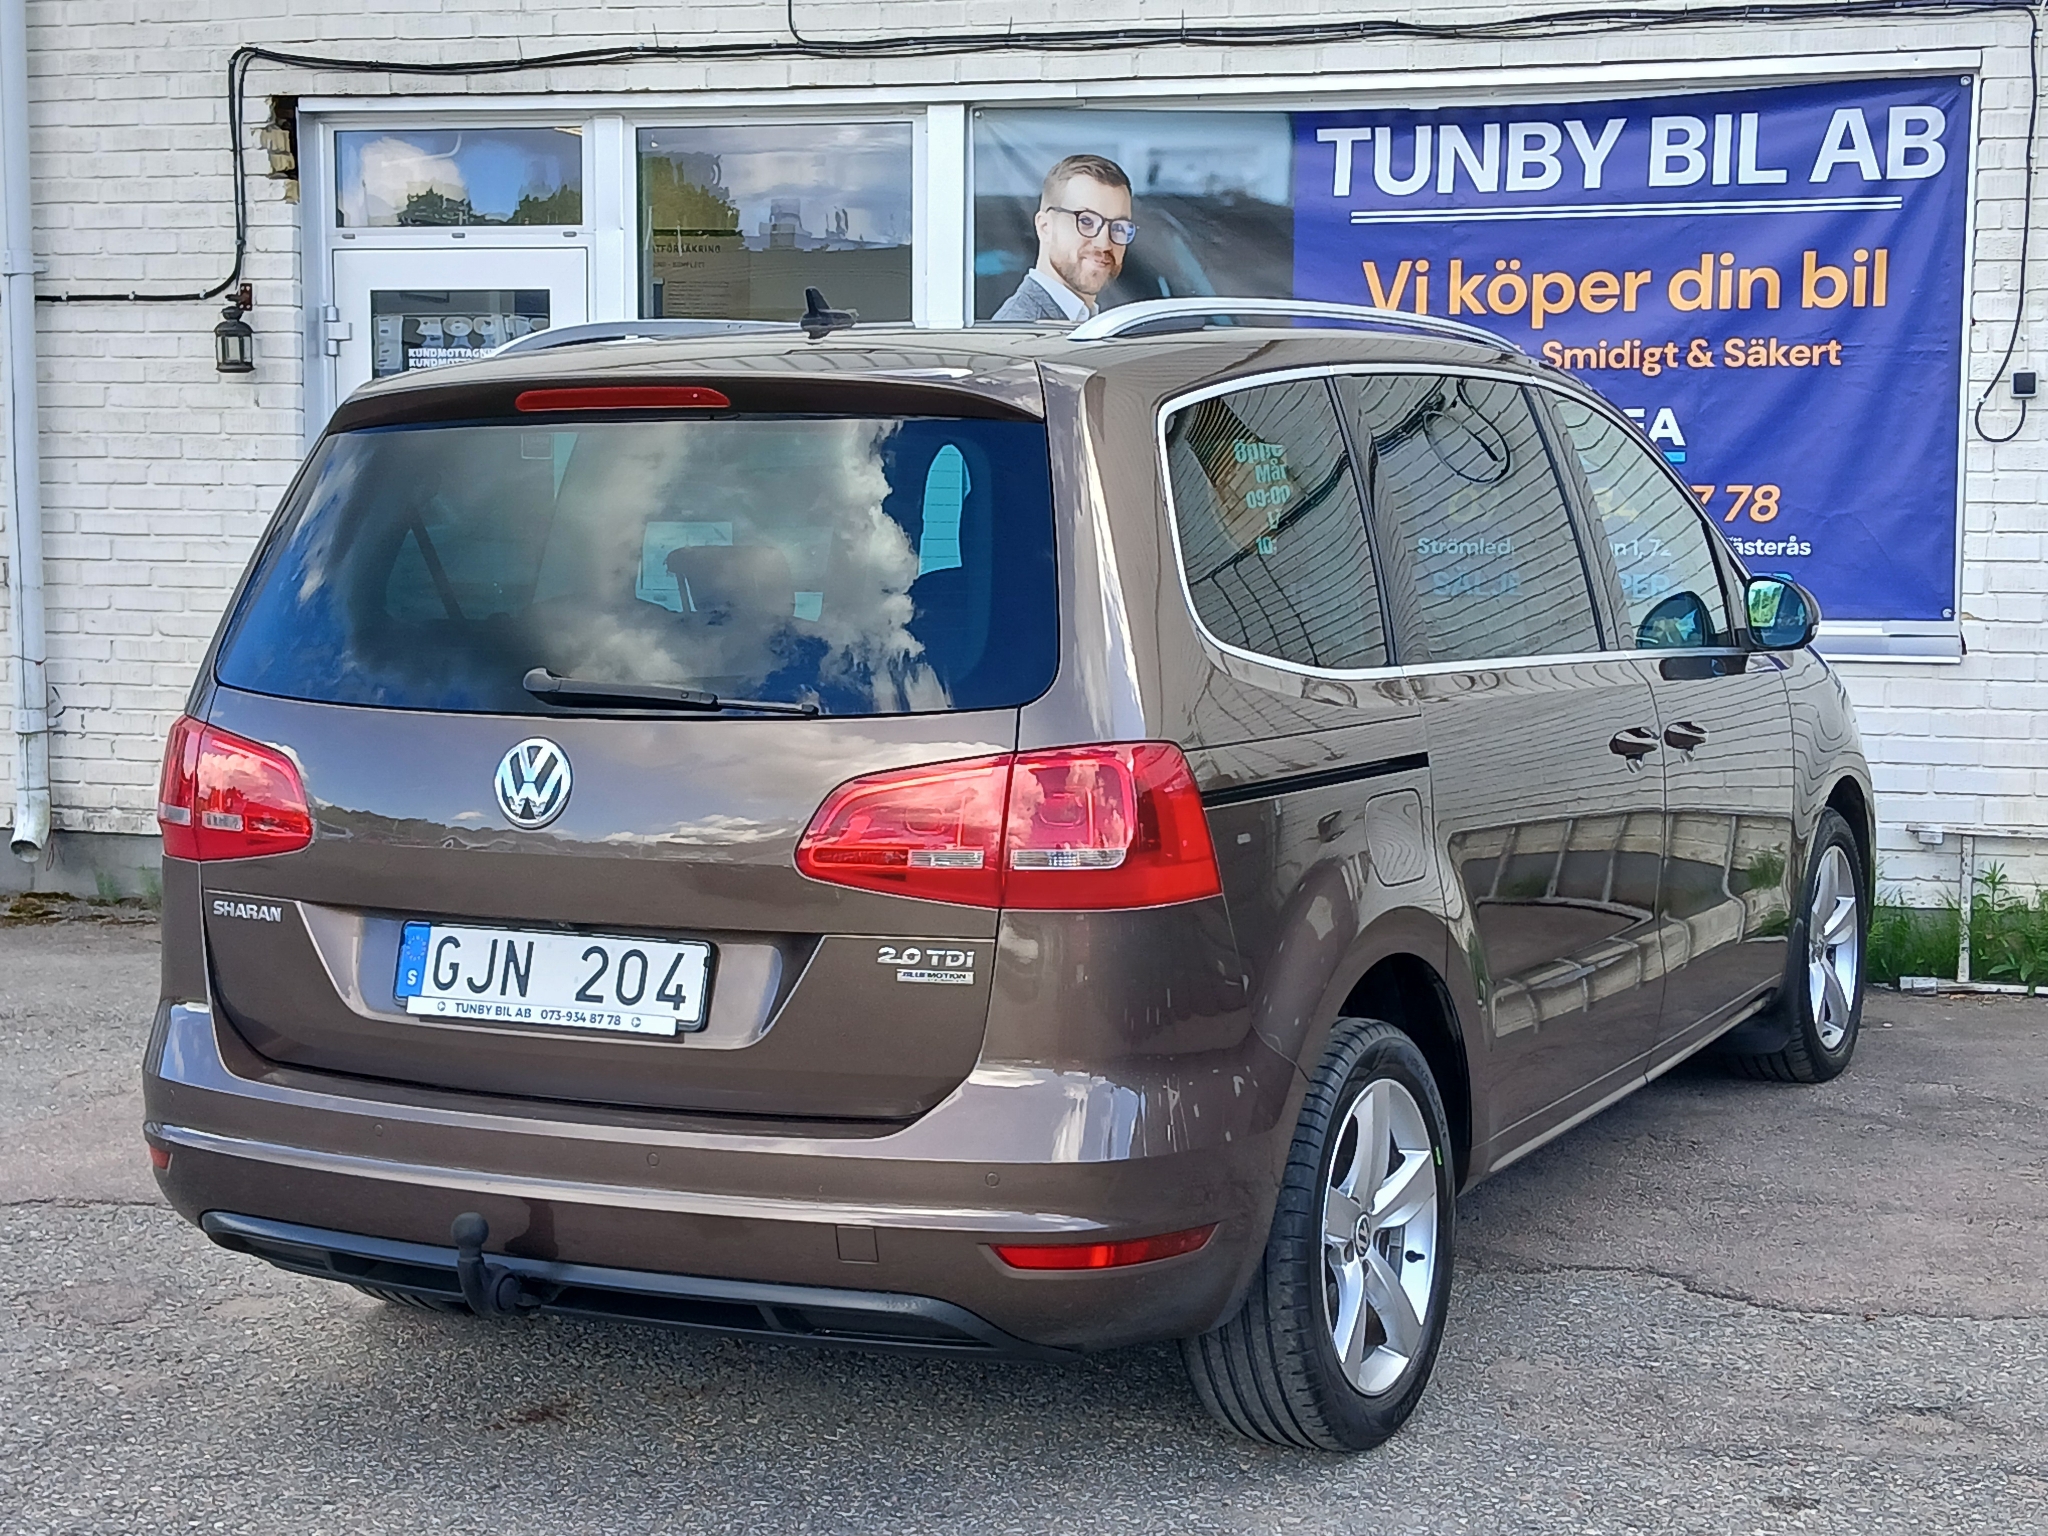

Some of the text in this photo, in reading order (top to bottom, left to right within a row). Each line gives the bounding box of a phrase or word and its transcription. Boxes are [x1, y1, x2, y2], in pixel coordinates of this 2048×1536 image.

[1316, 105, 1946, 197] TUNBY BIL AB
[1362, 248, 1888, 329] Vi köper din bil
[1542, 338, 1842, 376] Smidigt & Säkert
[1724, 484, 1781, 522] 78
[1417, 537, 1515, 555] Strömled
[1727, 535, 1812, 556] ästerås
[213, 900, 282, 922] SHARAN
[406, 969, 418, 986] S
[432, 936, 687, 1011] GJN 204
[455, 1002, 621, 1026] TUNBY BIL AB 073-934 87 78
